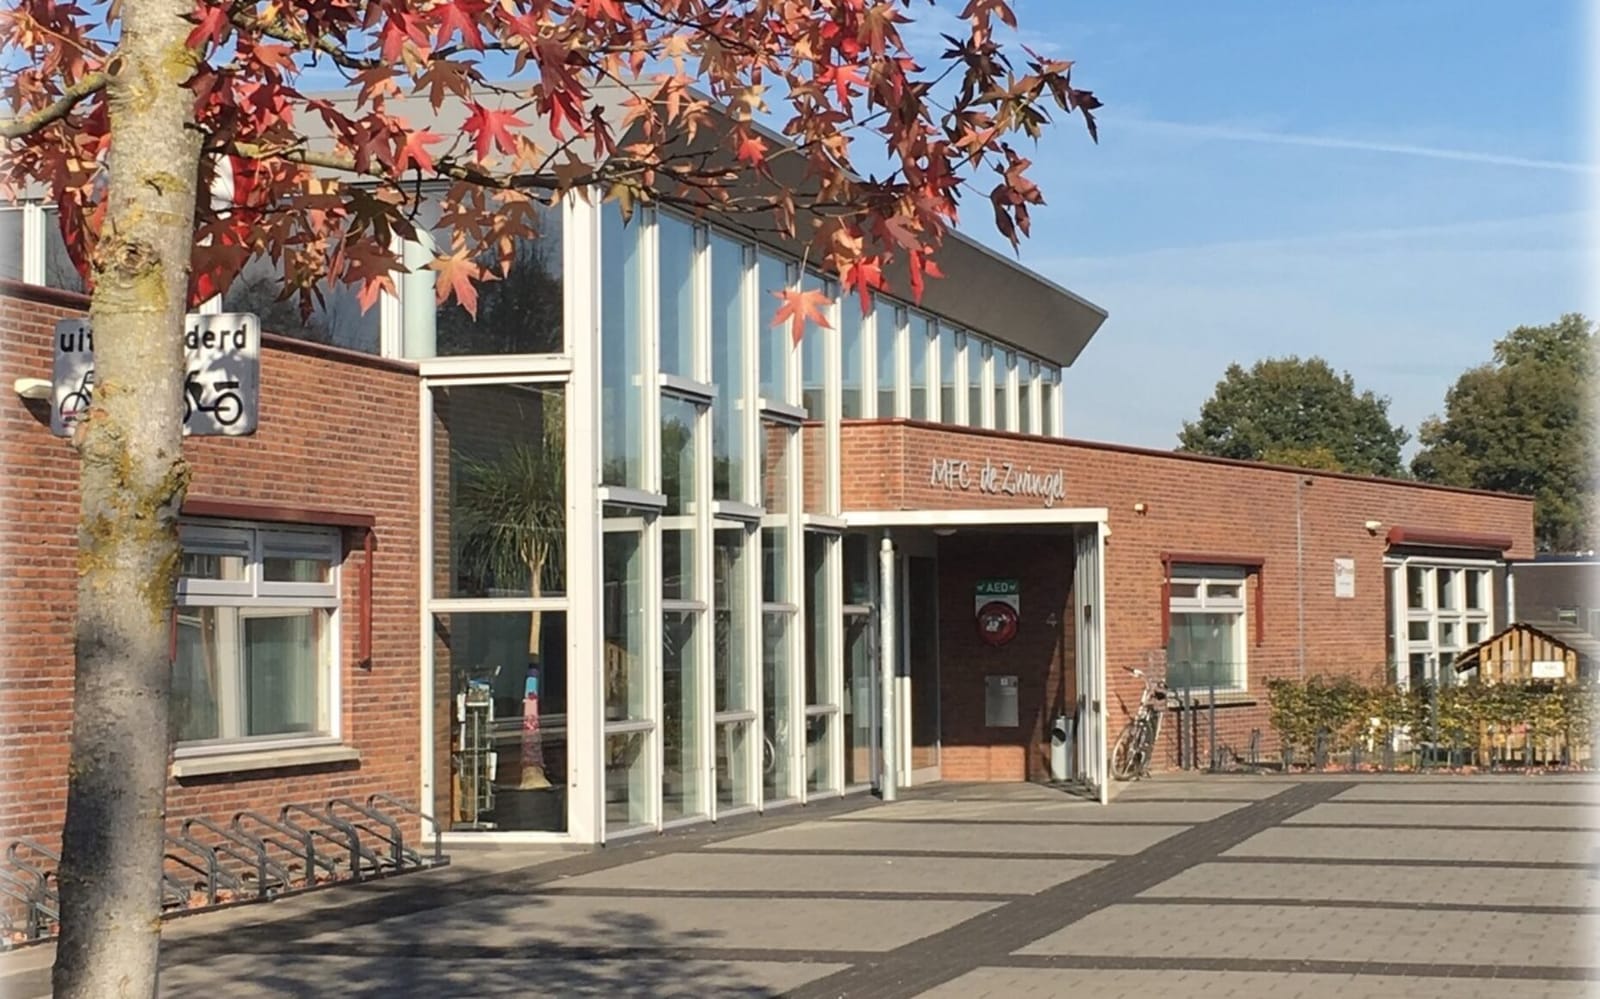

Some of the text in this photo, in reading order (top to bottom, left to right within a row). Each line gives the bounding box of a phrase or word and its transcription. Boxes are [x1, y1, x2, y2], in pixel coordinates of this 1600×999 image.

[930, 457, 1066, 507] MFC de Zwingel
[986, 582, 1009, 593] AED
